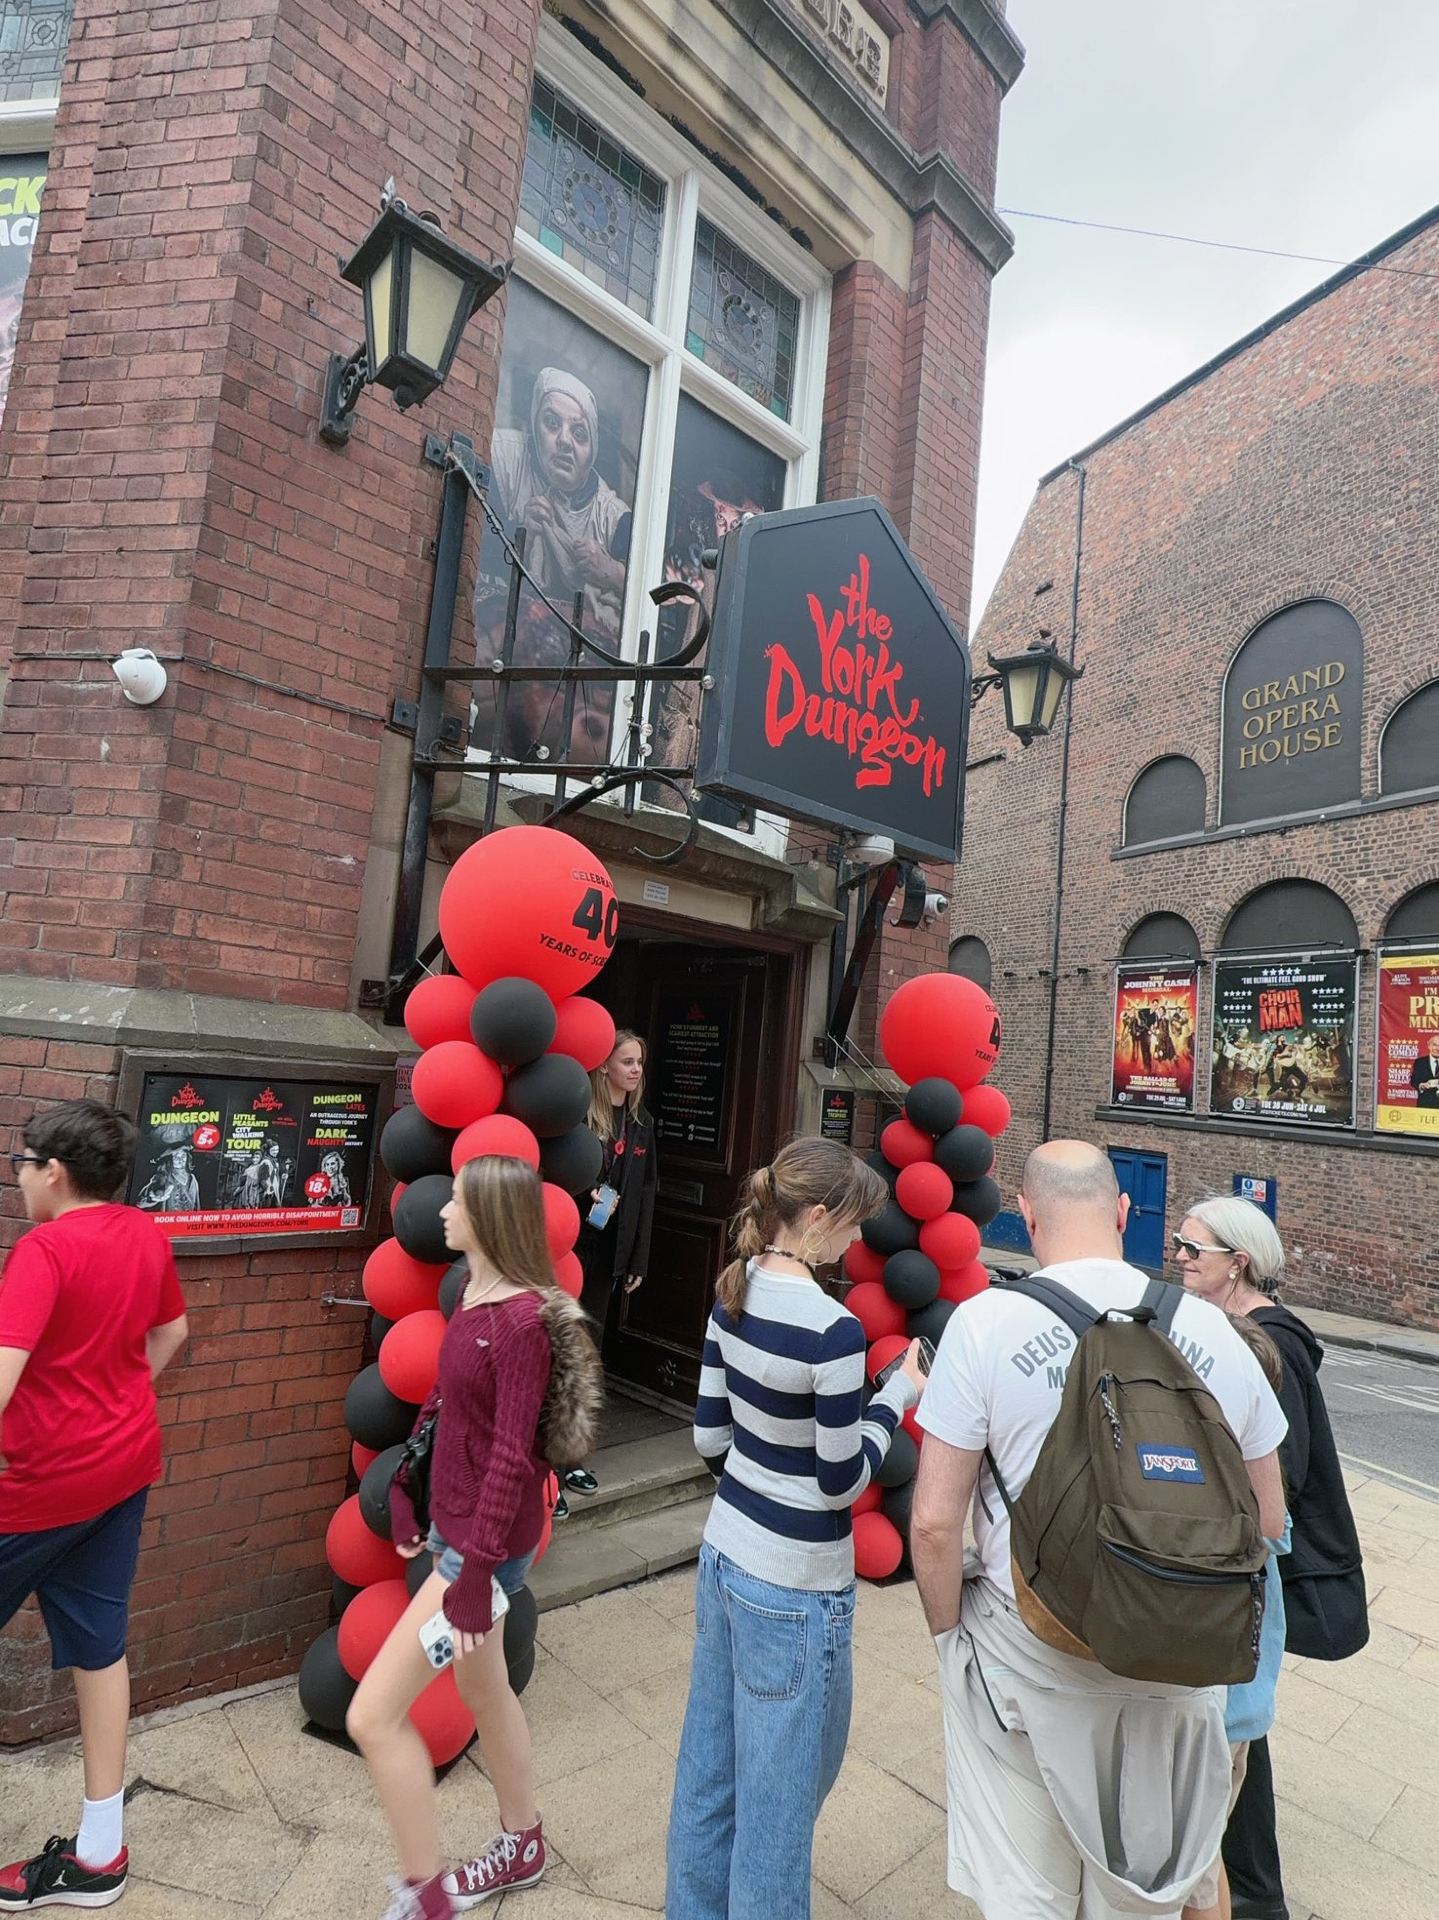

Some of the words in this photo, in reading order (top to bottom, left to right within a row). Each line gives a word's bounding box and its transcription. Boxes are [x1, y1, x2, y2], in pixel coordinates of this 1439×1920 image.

[840, 553, 893, 640] the
[806, 594, 919, 727] York
[1242, 662, 1345, 711] GRAND
[764, 643, 946, 797] Dungeon
[1243, 693, 1341, 740] OPERA
[1239, 722, 1343, 769] HOUSE
[572, 887, 619, 949] 40
[539, 933, 578, 957] YEARS
[578, 951, 593, 963] OF
[1124, 980, 1163, 989] JOHNNY
[1163, 978, 1191, 987] CASH
[1278, 975, 1291, 983] FEEL
[1259, 989, 1300, 1008] CHOIR
[1259, 1003, 1303, 1031] MAN
[313, 1094, 362, 1104] DUNGEON
[345, 1103, 366, 1111] LATES
[150, 1111, 220, 1125] DUNGEON
[315, 1128, 348, 1138] DARK
[226, 1139, 261, 1149] TOUR
[307, 1138, 345, 1146] NAUGHTY
[308, 1180, 328, 1193] 18+
[175, 1215, 202, 1223] ONLINE
[203, 1214, 220, 1222] NOW
[285, 1210, 340, 1219] DISAPPOINTMENT
[186, 1223, 205, 1231] VISIT
[1010, 1325, 1072, 1378] DEUS
